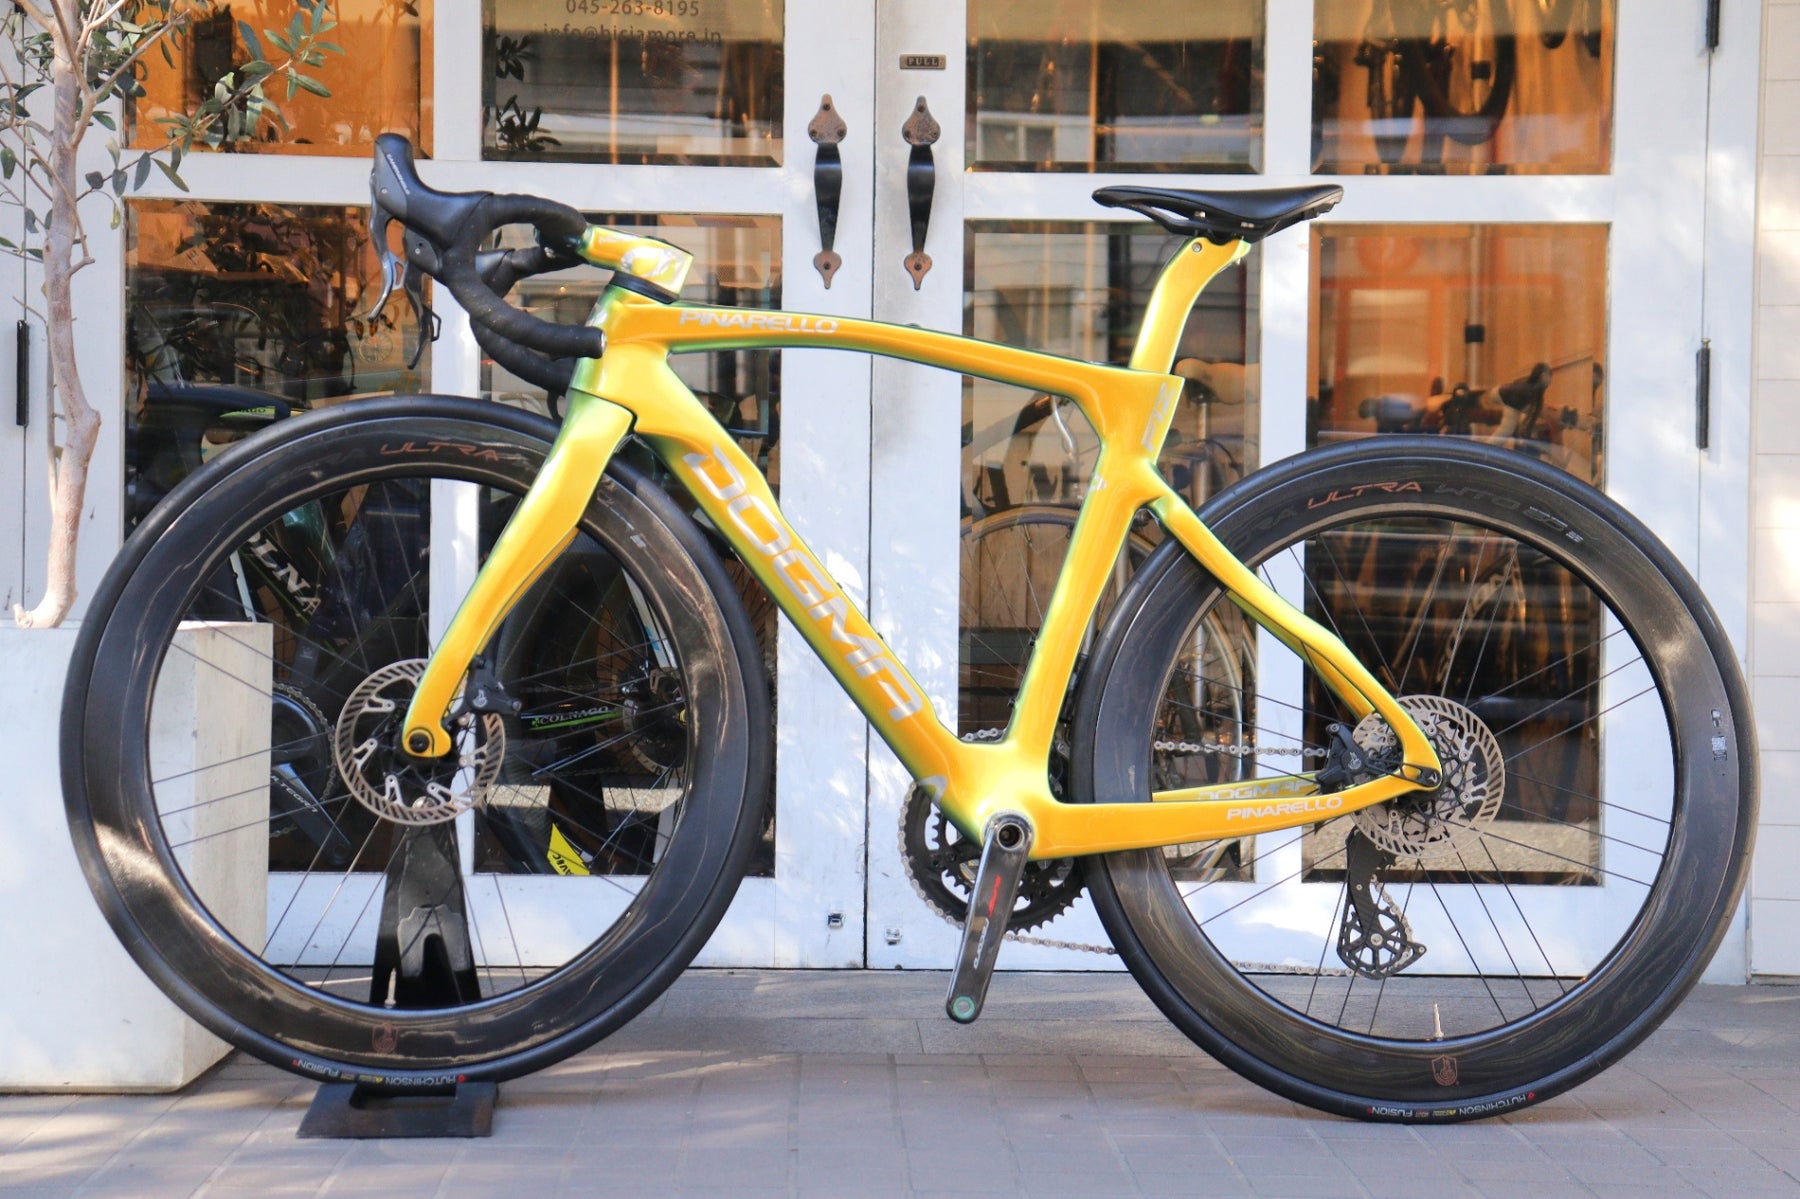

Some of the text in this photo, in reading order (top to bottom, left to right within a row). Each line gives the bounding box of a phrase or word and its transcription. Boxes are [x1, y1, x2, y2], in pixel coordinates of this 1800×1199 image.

[566, 0, 699, 17] 045-263-8195
[908, 57, 938, 66] PULL
[679, 309, 838, 334] PINARELLO
[380, 441, 499, 462] ULTRA
[1307, 481, 1422, 510] ULTRA
[540, 705, 609, 725] COLNAGO
[1226, 797, 1343, 821] PINARELLO
[298, 1058, 340, 1077] FUSION
[385, 1075, 456, 1087] HUTCHINSON
[1372, 1105, 1413, 1118] FUSION
[1459, 1093, 1526, 1116] HUTCHINSON
